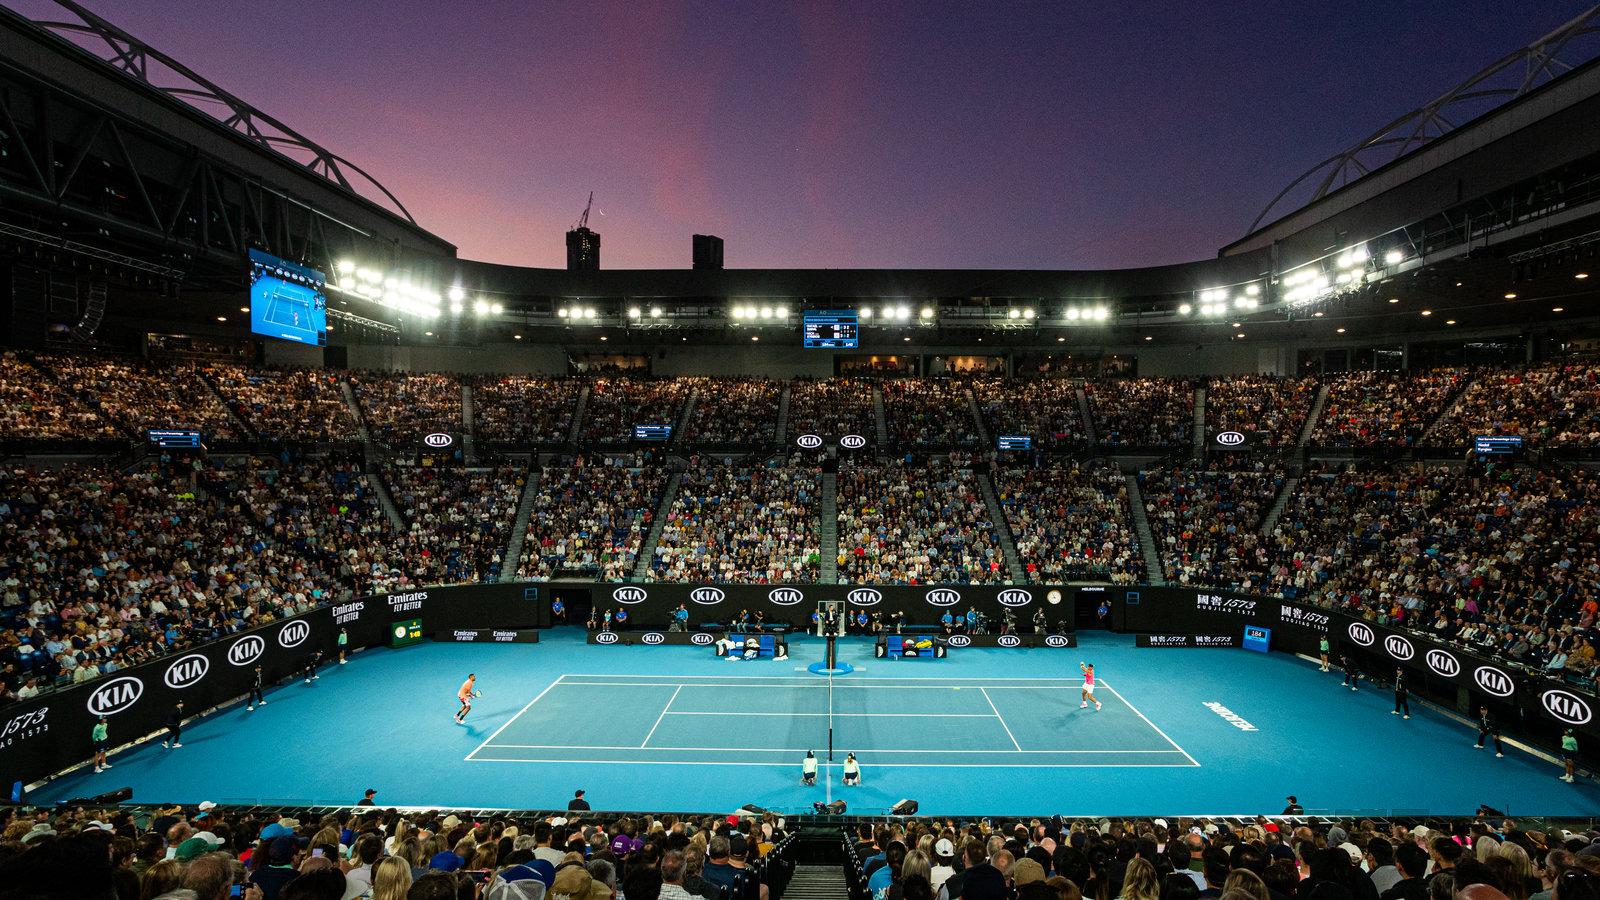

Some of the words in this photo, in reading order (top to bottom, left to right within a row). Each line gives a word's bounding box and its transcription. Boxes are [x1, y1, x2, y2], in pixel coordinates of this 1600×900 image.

[388, 592, 428, 604] Emirates
[403, 601, 422, 610] BETTER
[332, 601, 364, 617] Emirates
[98, 682, 135, 710] KIA
[1550, 694, 1582, 720] KIA
[0, 707, 49, 738] 1573
[21, 724, 49, 739] 1573
